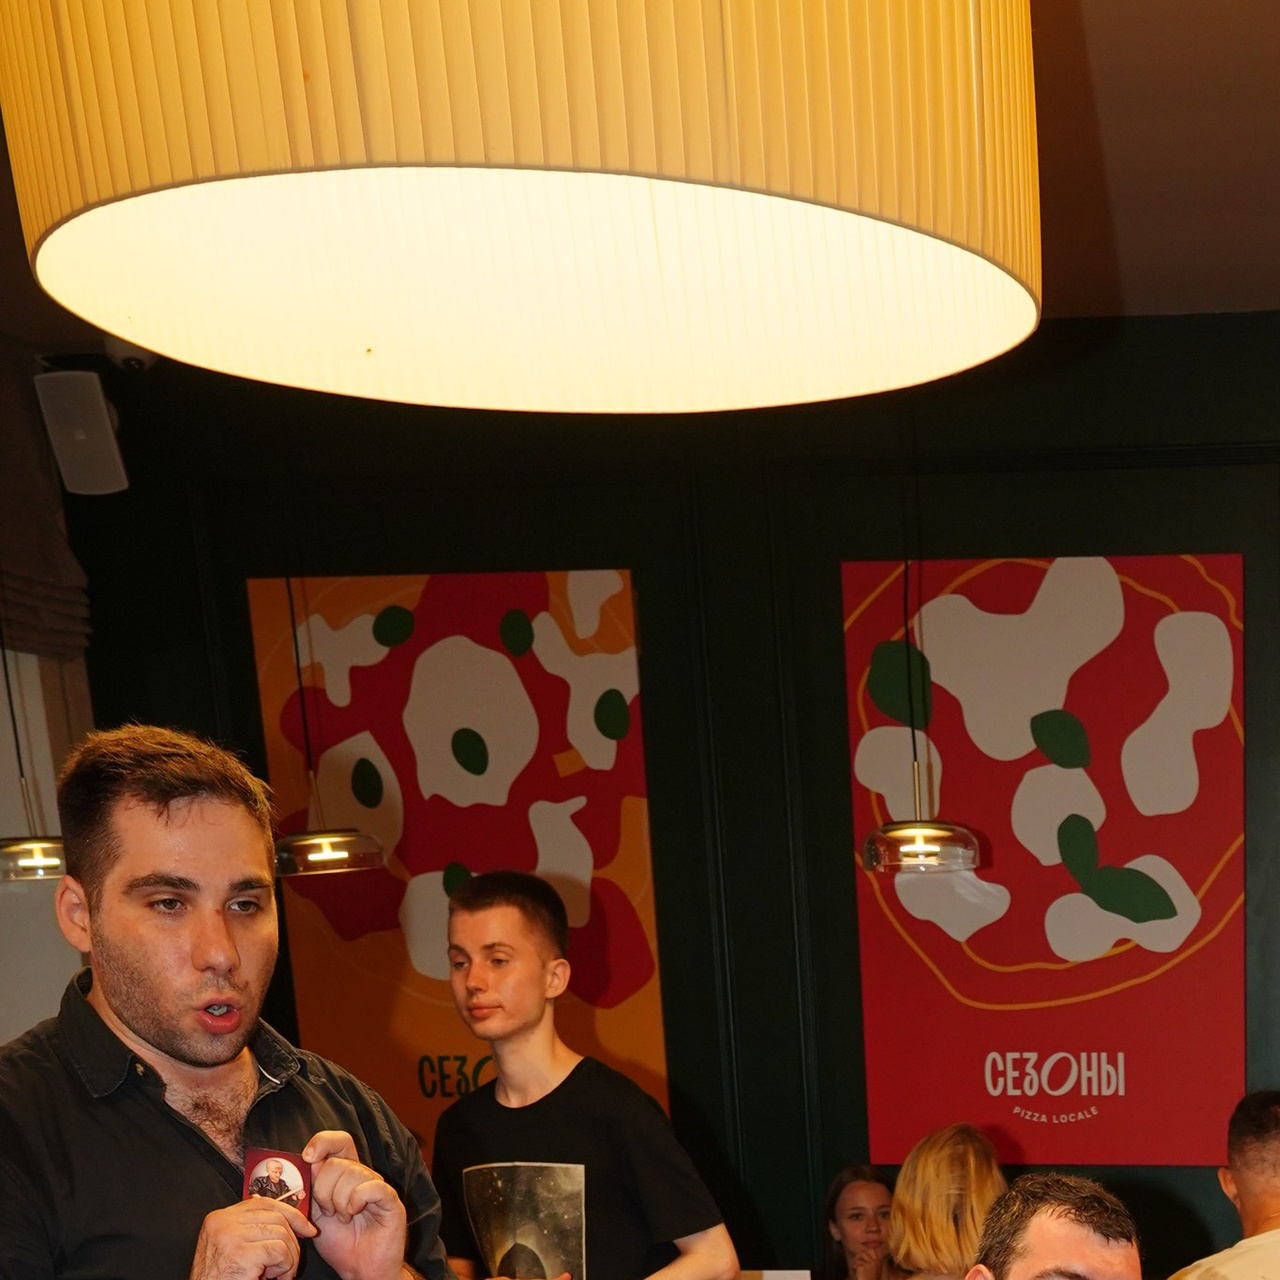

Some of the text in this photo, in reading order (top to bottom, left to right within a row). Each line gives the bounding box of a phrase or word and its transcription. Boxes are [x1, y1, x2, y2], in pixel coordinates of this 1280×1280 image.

[984, 1051, 1126, 1097] СЕЗОНЫ
[1013, 1105, 1099, 1124] PIZZA LOCALE
